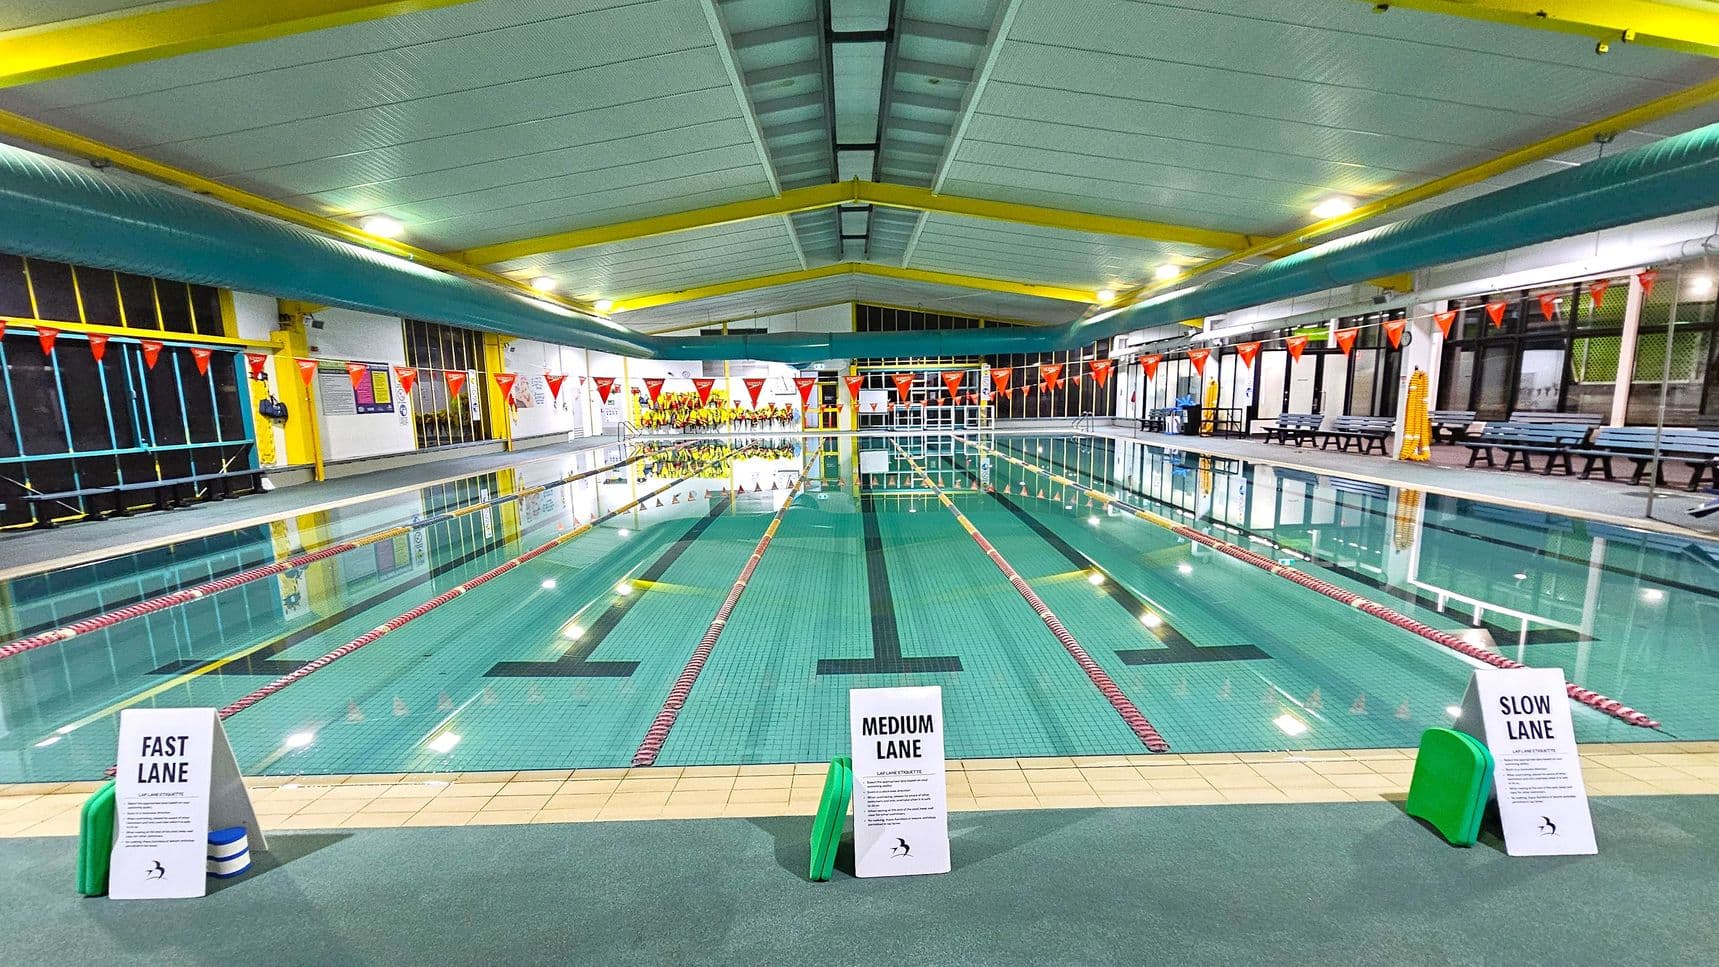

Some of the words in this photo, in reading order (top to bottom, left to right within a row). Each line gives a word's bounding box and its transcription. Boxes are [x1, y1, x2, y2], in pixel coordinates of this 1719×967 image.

[1500, 695, 1550, 715] SLOW
[862, 714, 934, 736] MEDIUM
[1506, 720, 1555, 740] LANE
[142, 736, 189, 757] FAST
[876, 739, 922, 760] LANE
[137, 762, 189, 783] LANE
